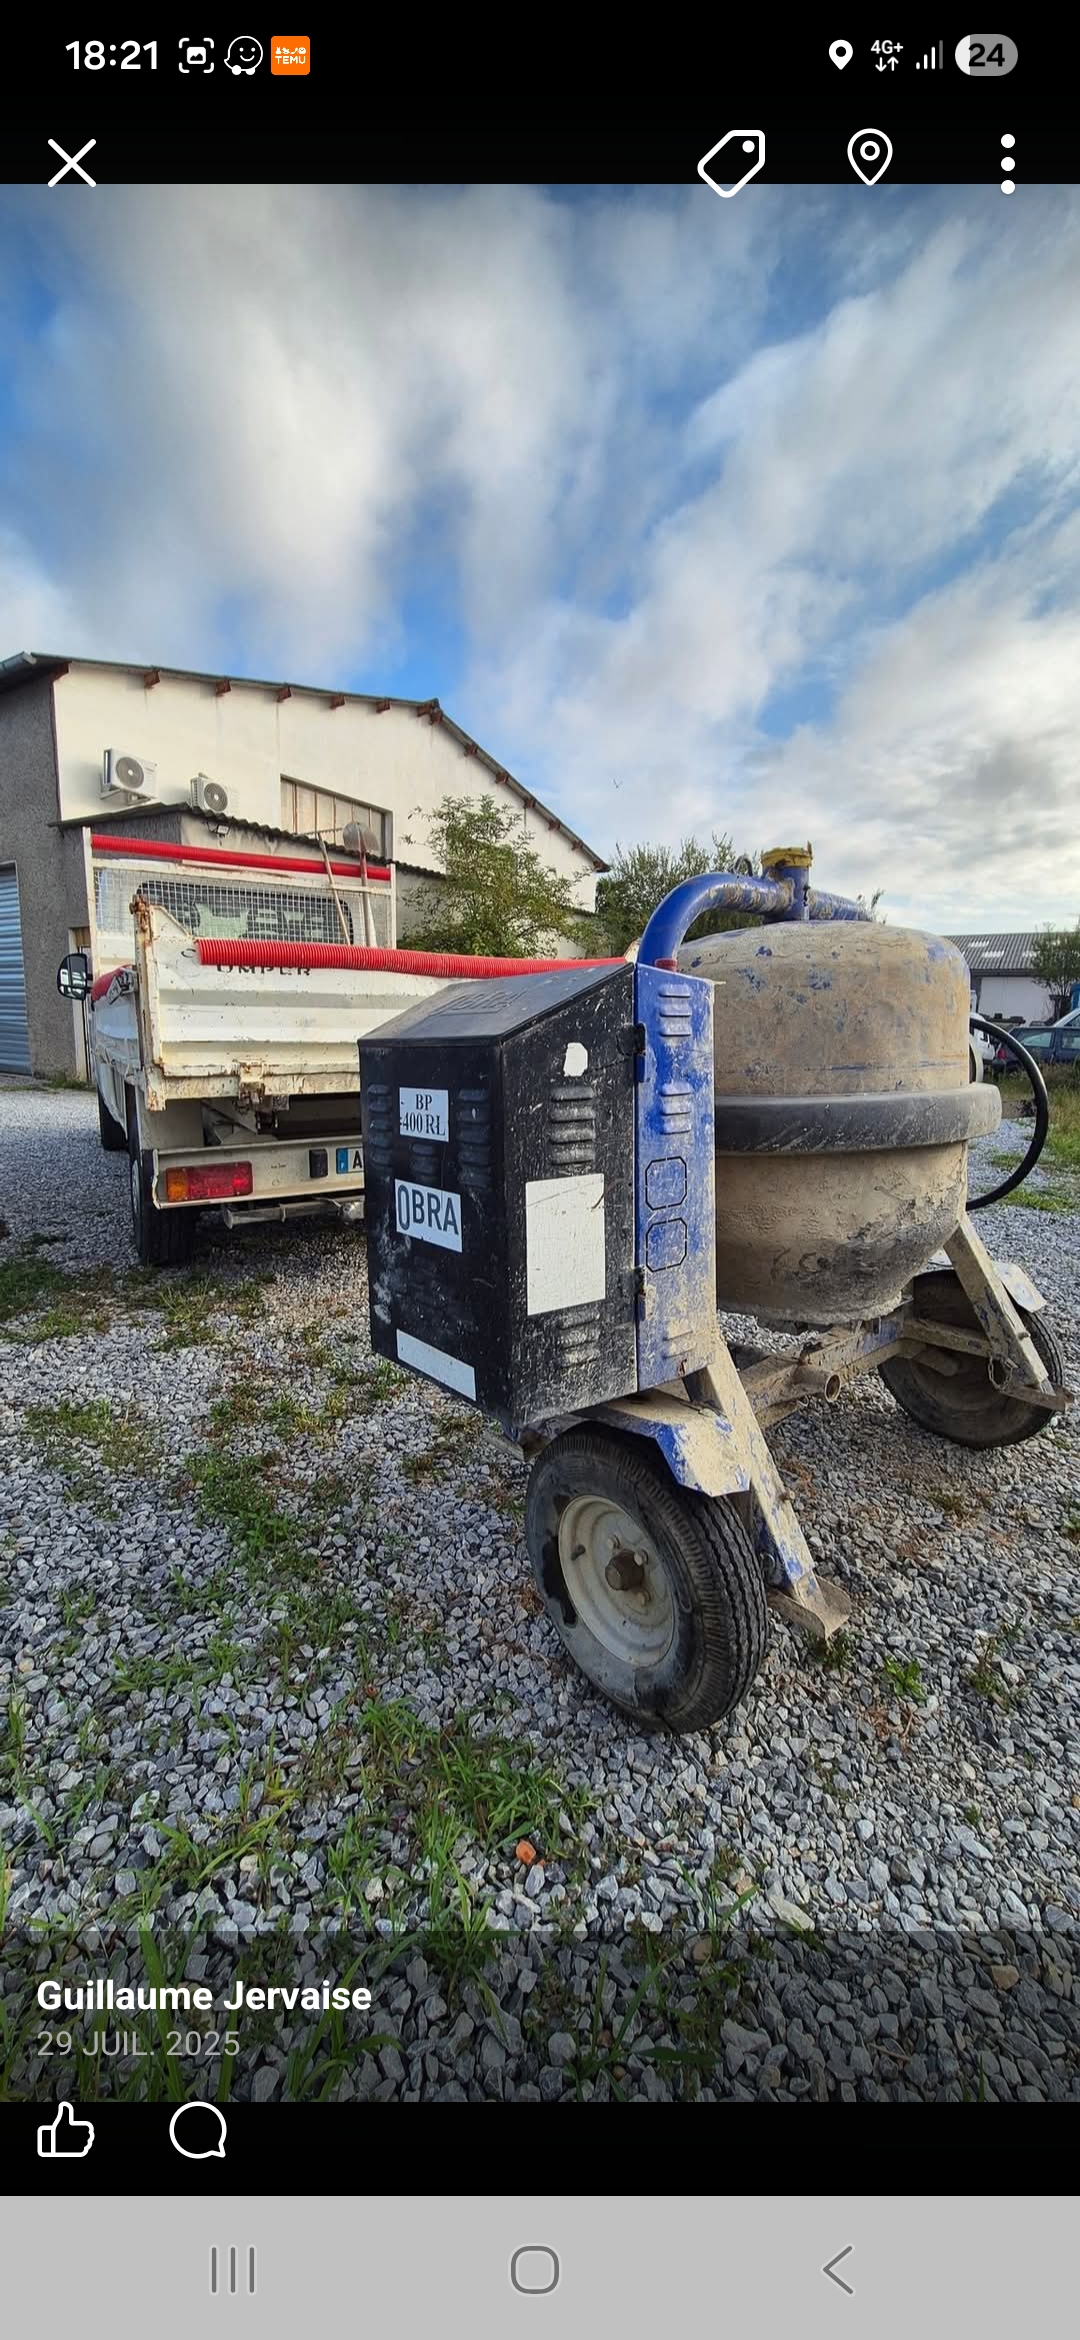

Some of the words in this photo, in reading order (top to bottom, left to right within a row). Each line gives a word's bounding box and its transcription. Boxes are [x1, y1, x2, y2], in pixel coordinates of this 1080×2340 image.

[415, 1093, 433, 1111] BP
[425, 1113, 446, 1137] RL
[397, 1184, 459, 1236] OBRA
